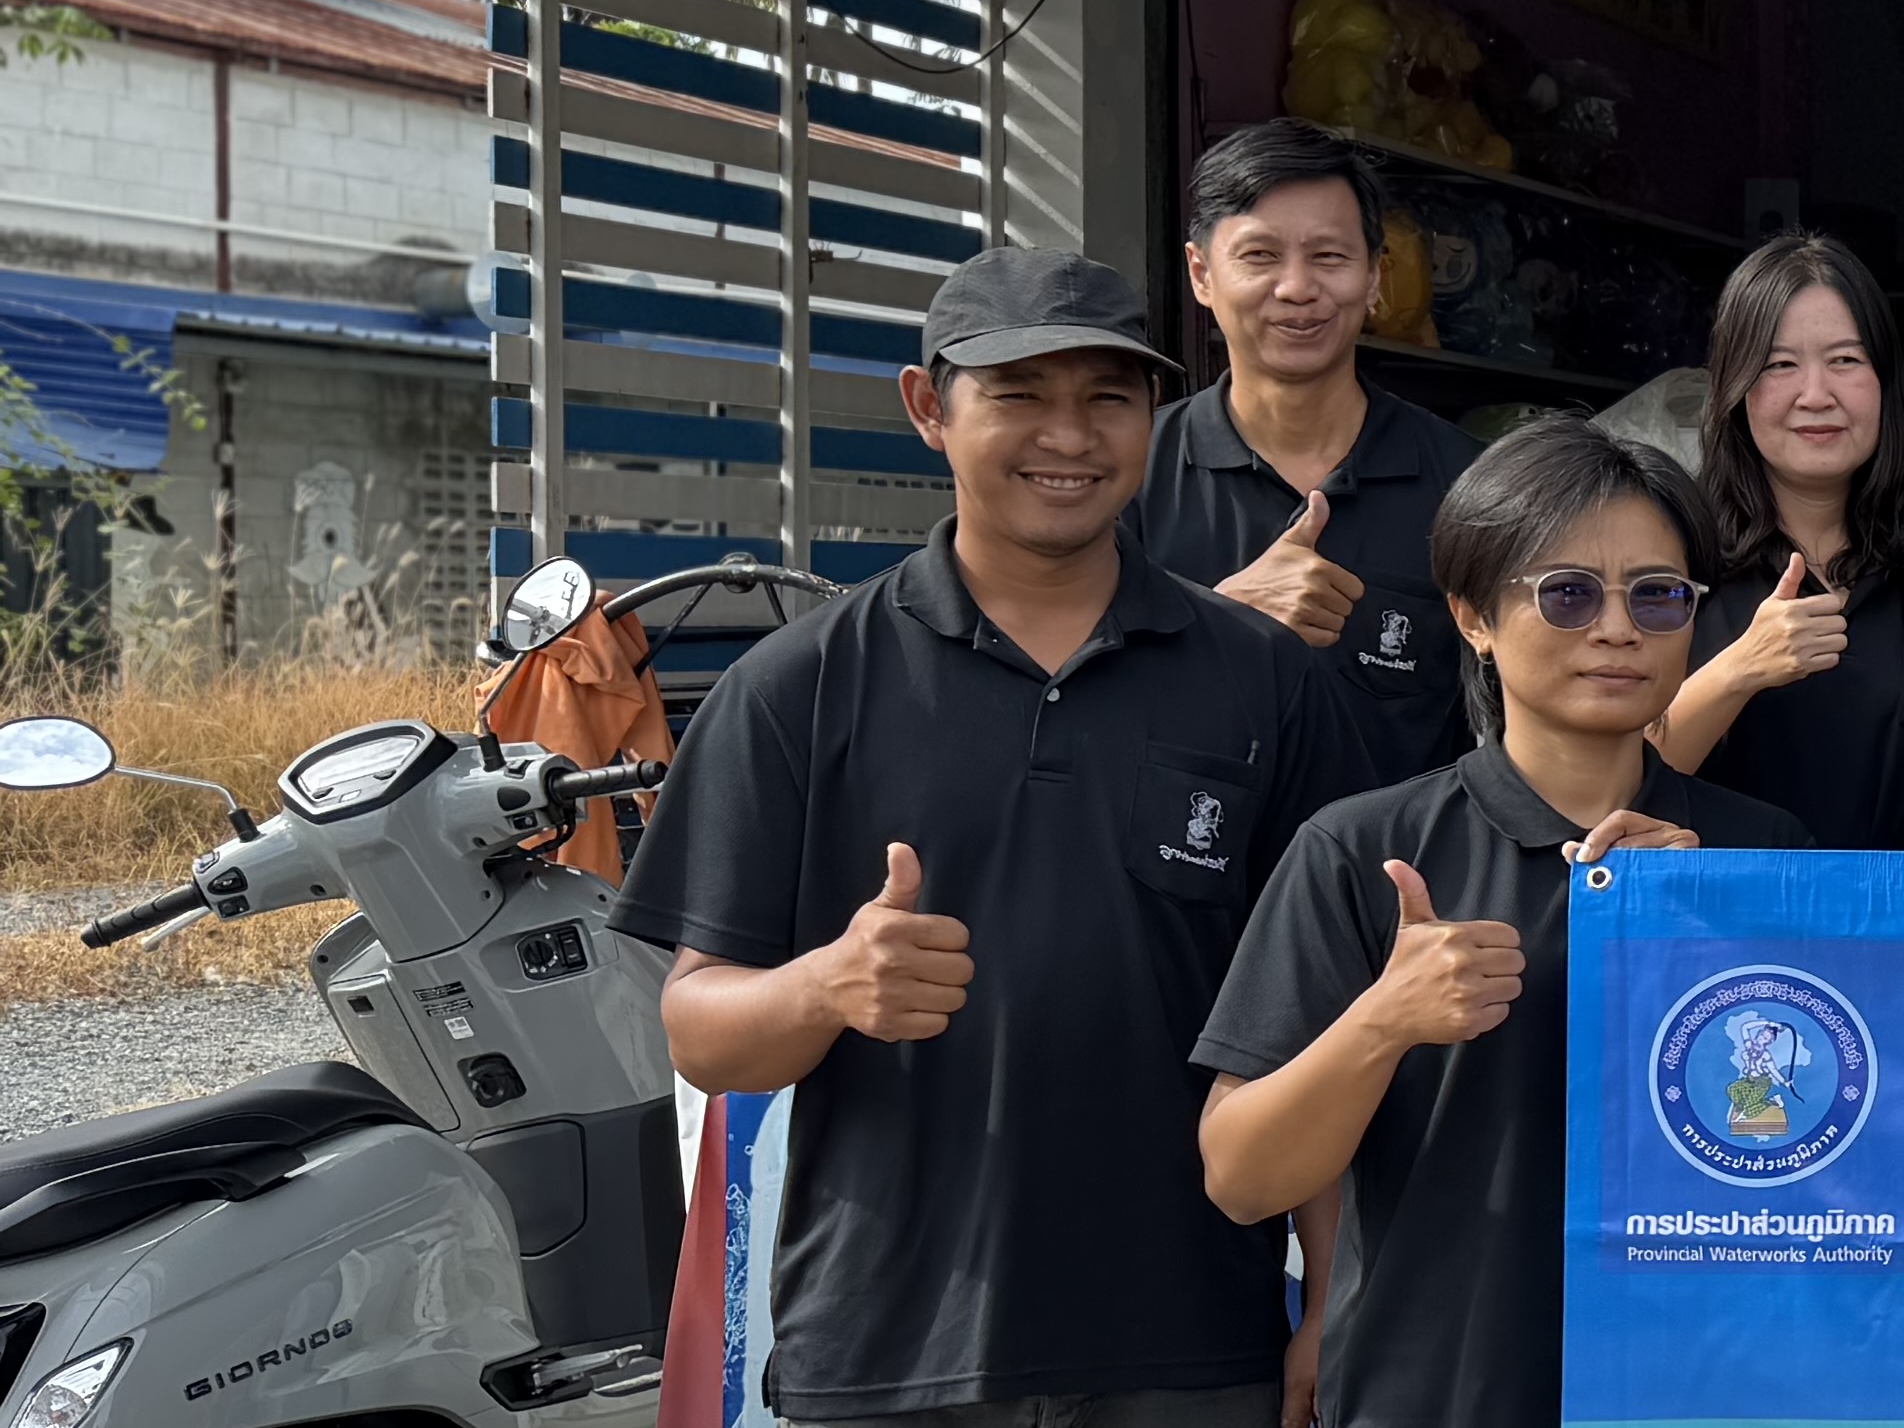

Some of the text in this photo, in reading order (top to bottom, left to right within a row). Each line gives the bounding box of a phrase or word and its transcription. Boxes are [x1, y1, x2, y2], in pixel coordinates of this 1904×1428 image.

[1625, 1208, 1896, 1243] การประปาส่วนภูมิภาค
[1627, 1245, 1894, 1265] Provincial Waterworks Authority
